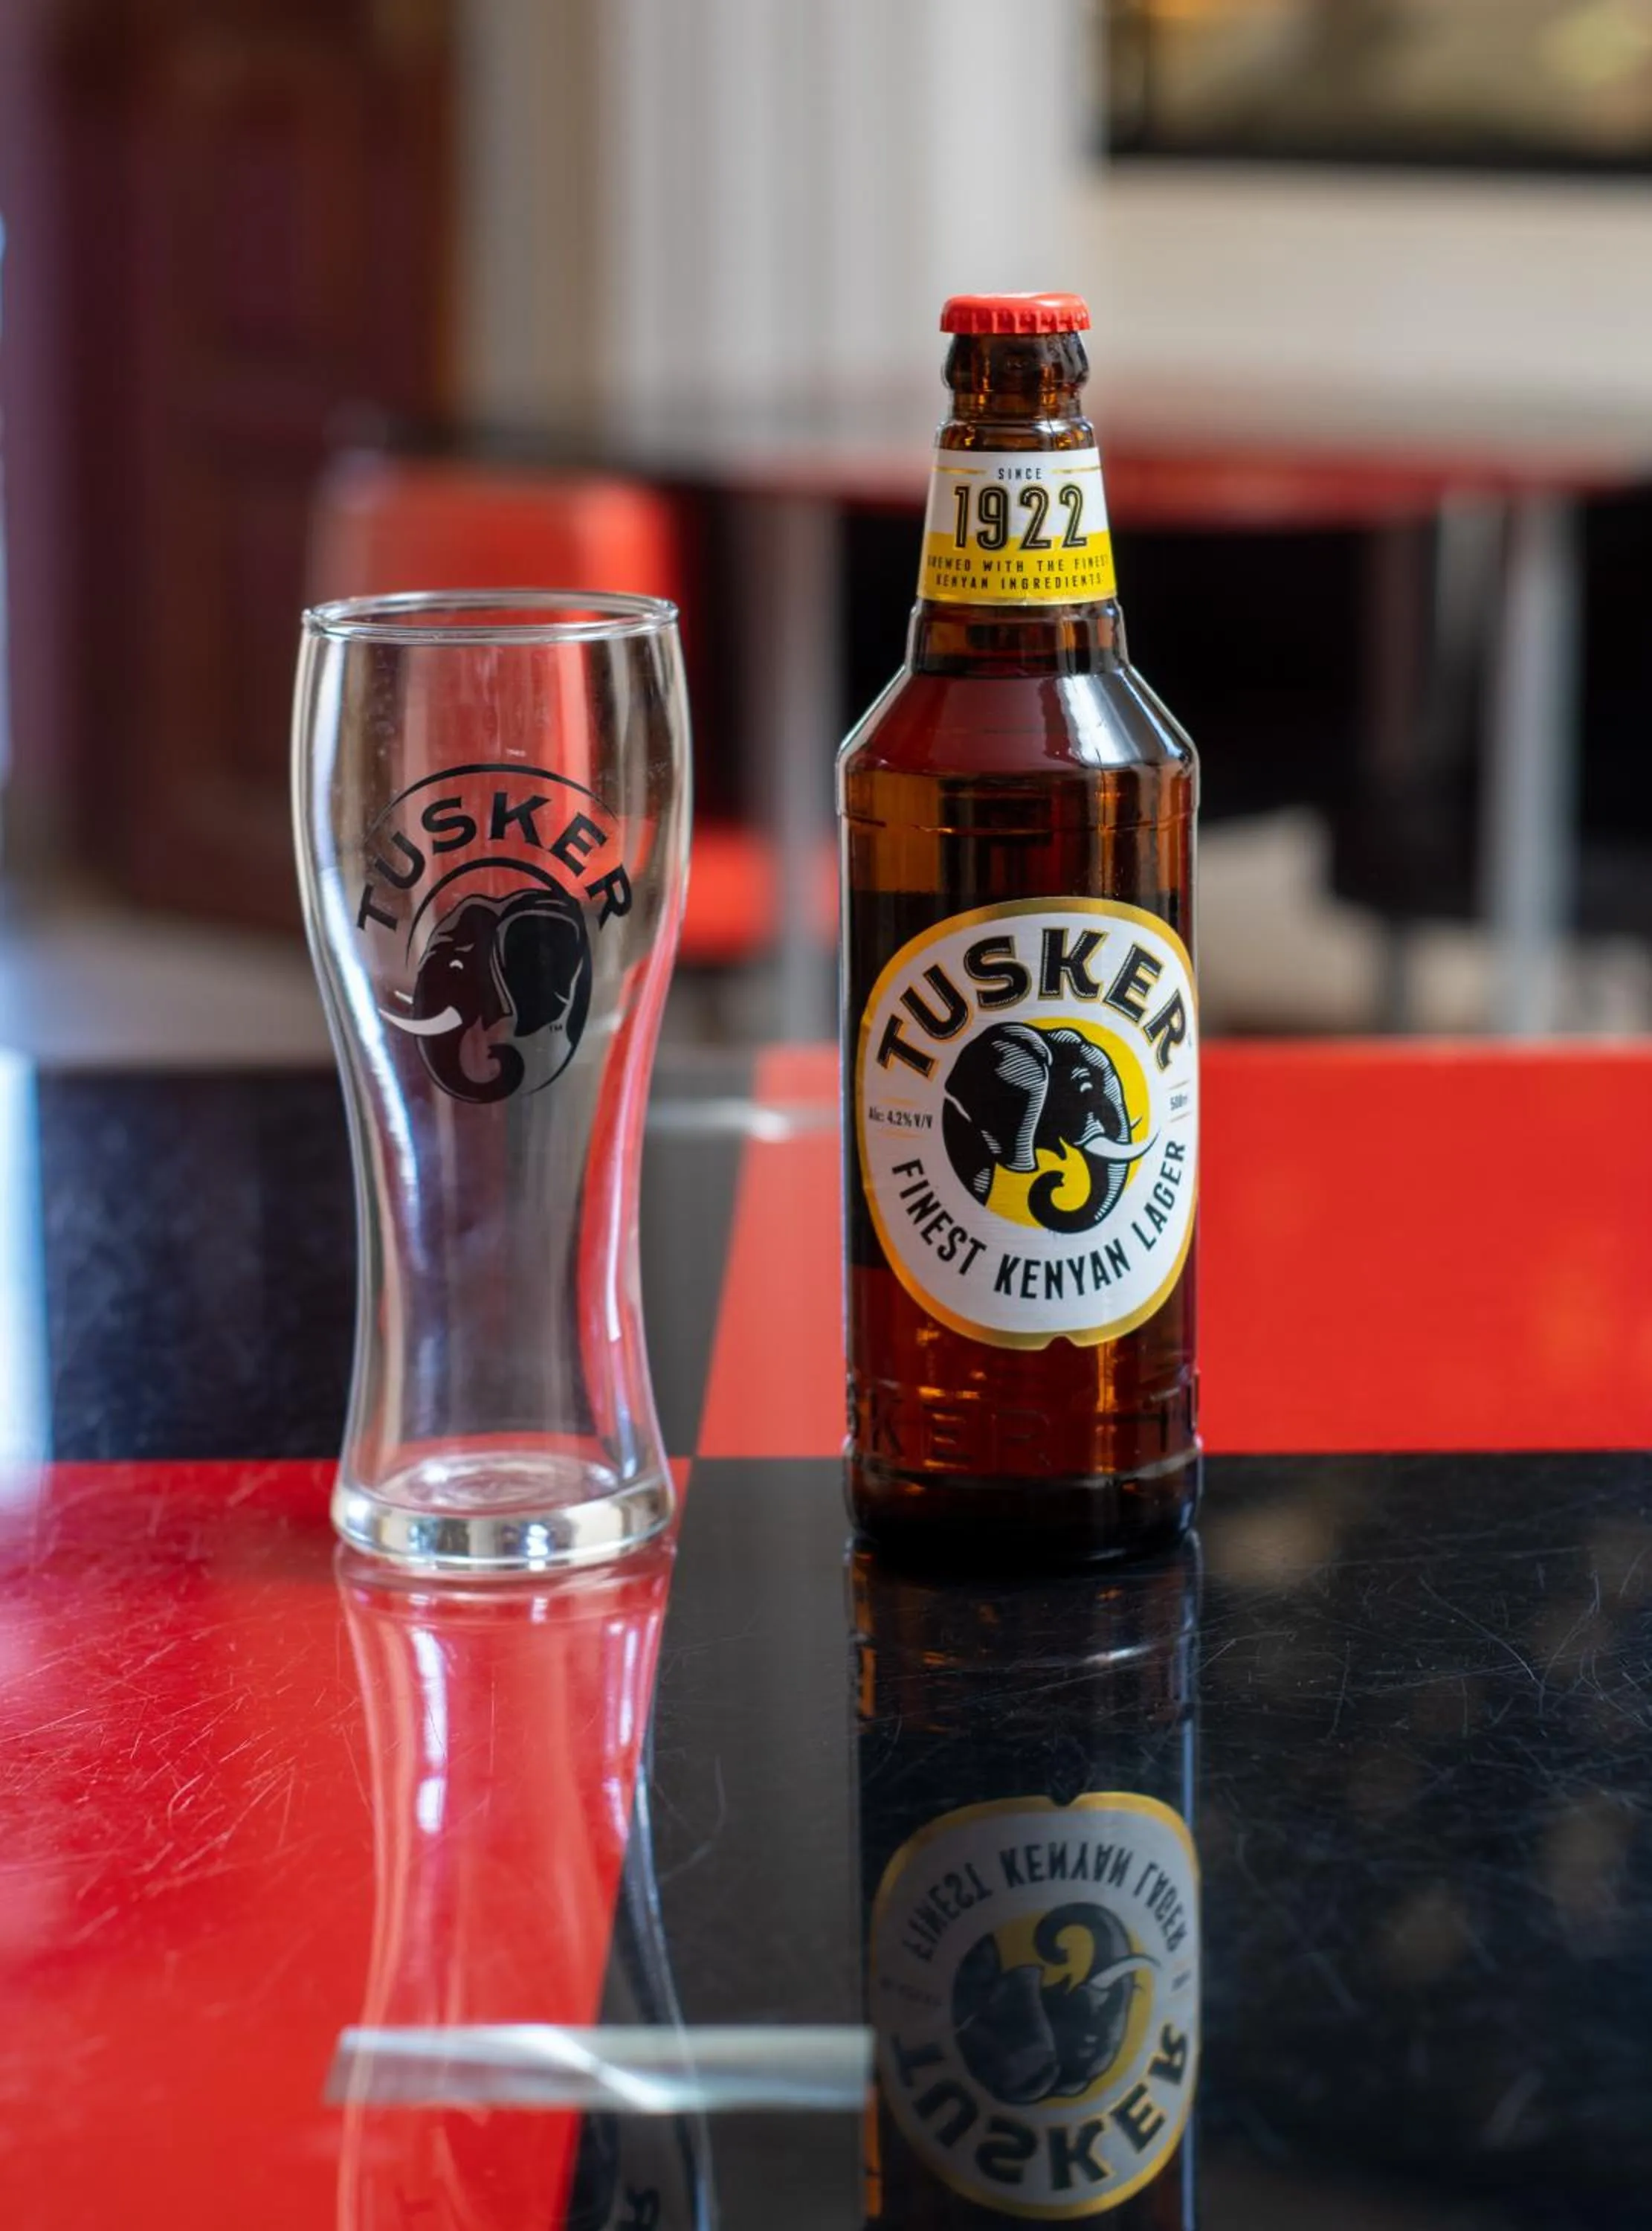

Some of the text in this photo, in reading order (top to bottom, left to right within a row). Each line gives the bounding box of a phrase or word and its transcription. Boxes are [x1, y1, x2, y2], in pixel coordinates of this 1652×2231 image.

[998, 468, 1042, 480] SINCE
[954, 484, 1088, 550] 1922
[936, 572, 1102, 590] KENYAN INGREDIENTS
[983, 559, 1024, 572] WITH
[1036, 558, 1064, 572] THE
[357, 791, 632, 933] TUSKER
[877, 927, 1187, 1078] TUSKER
[892, 1139, 1187, 1300] FINEST KENYAN LAGER
